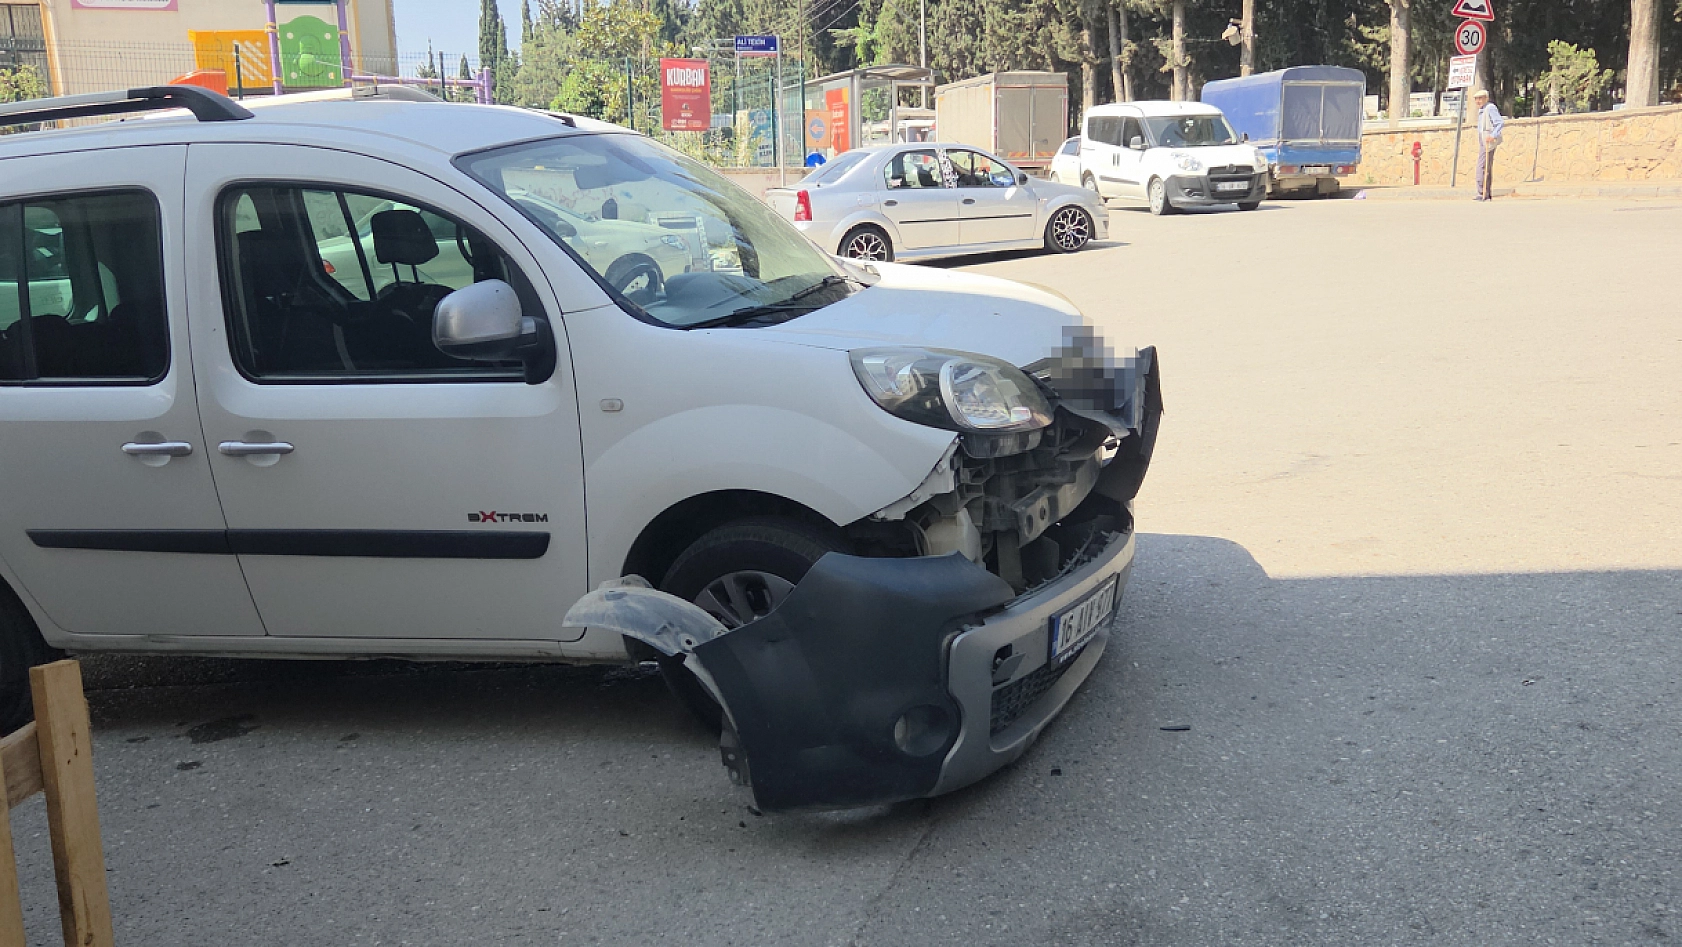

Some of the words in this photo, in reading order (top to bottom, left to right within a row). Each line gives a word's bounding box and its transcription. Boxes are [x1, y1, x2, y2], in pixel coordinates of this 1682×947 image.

[1461, 29, 1480, 46] 30
[666, 67, 705, 87] KURBAN
[1061, 613, 1074, 648] 16
